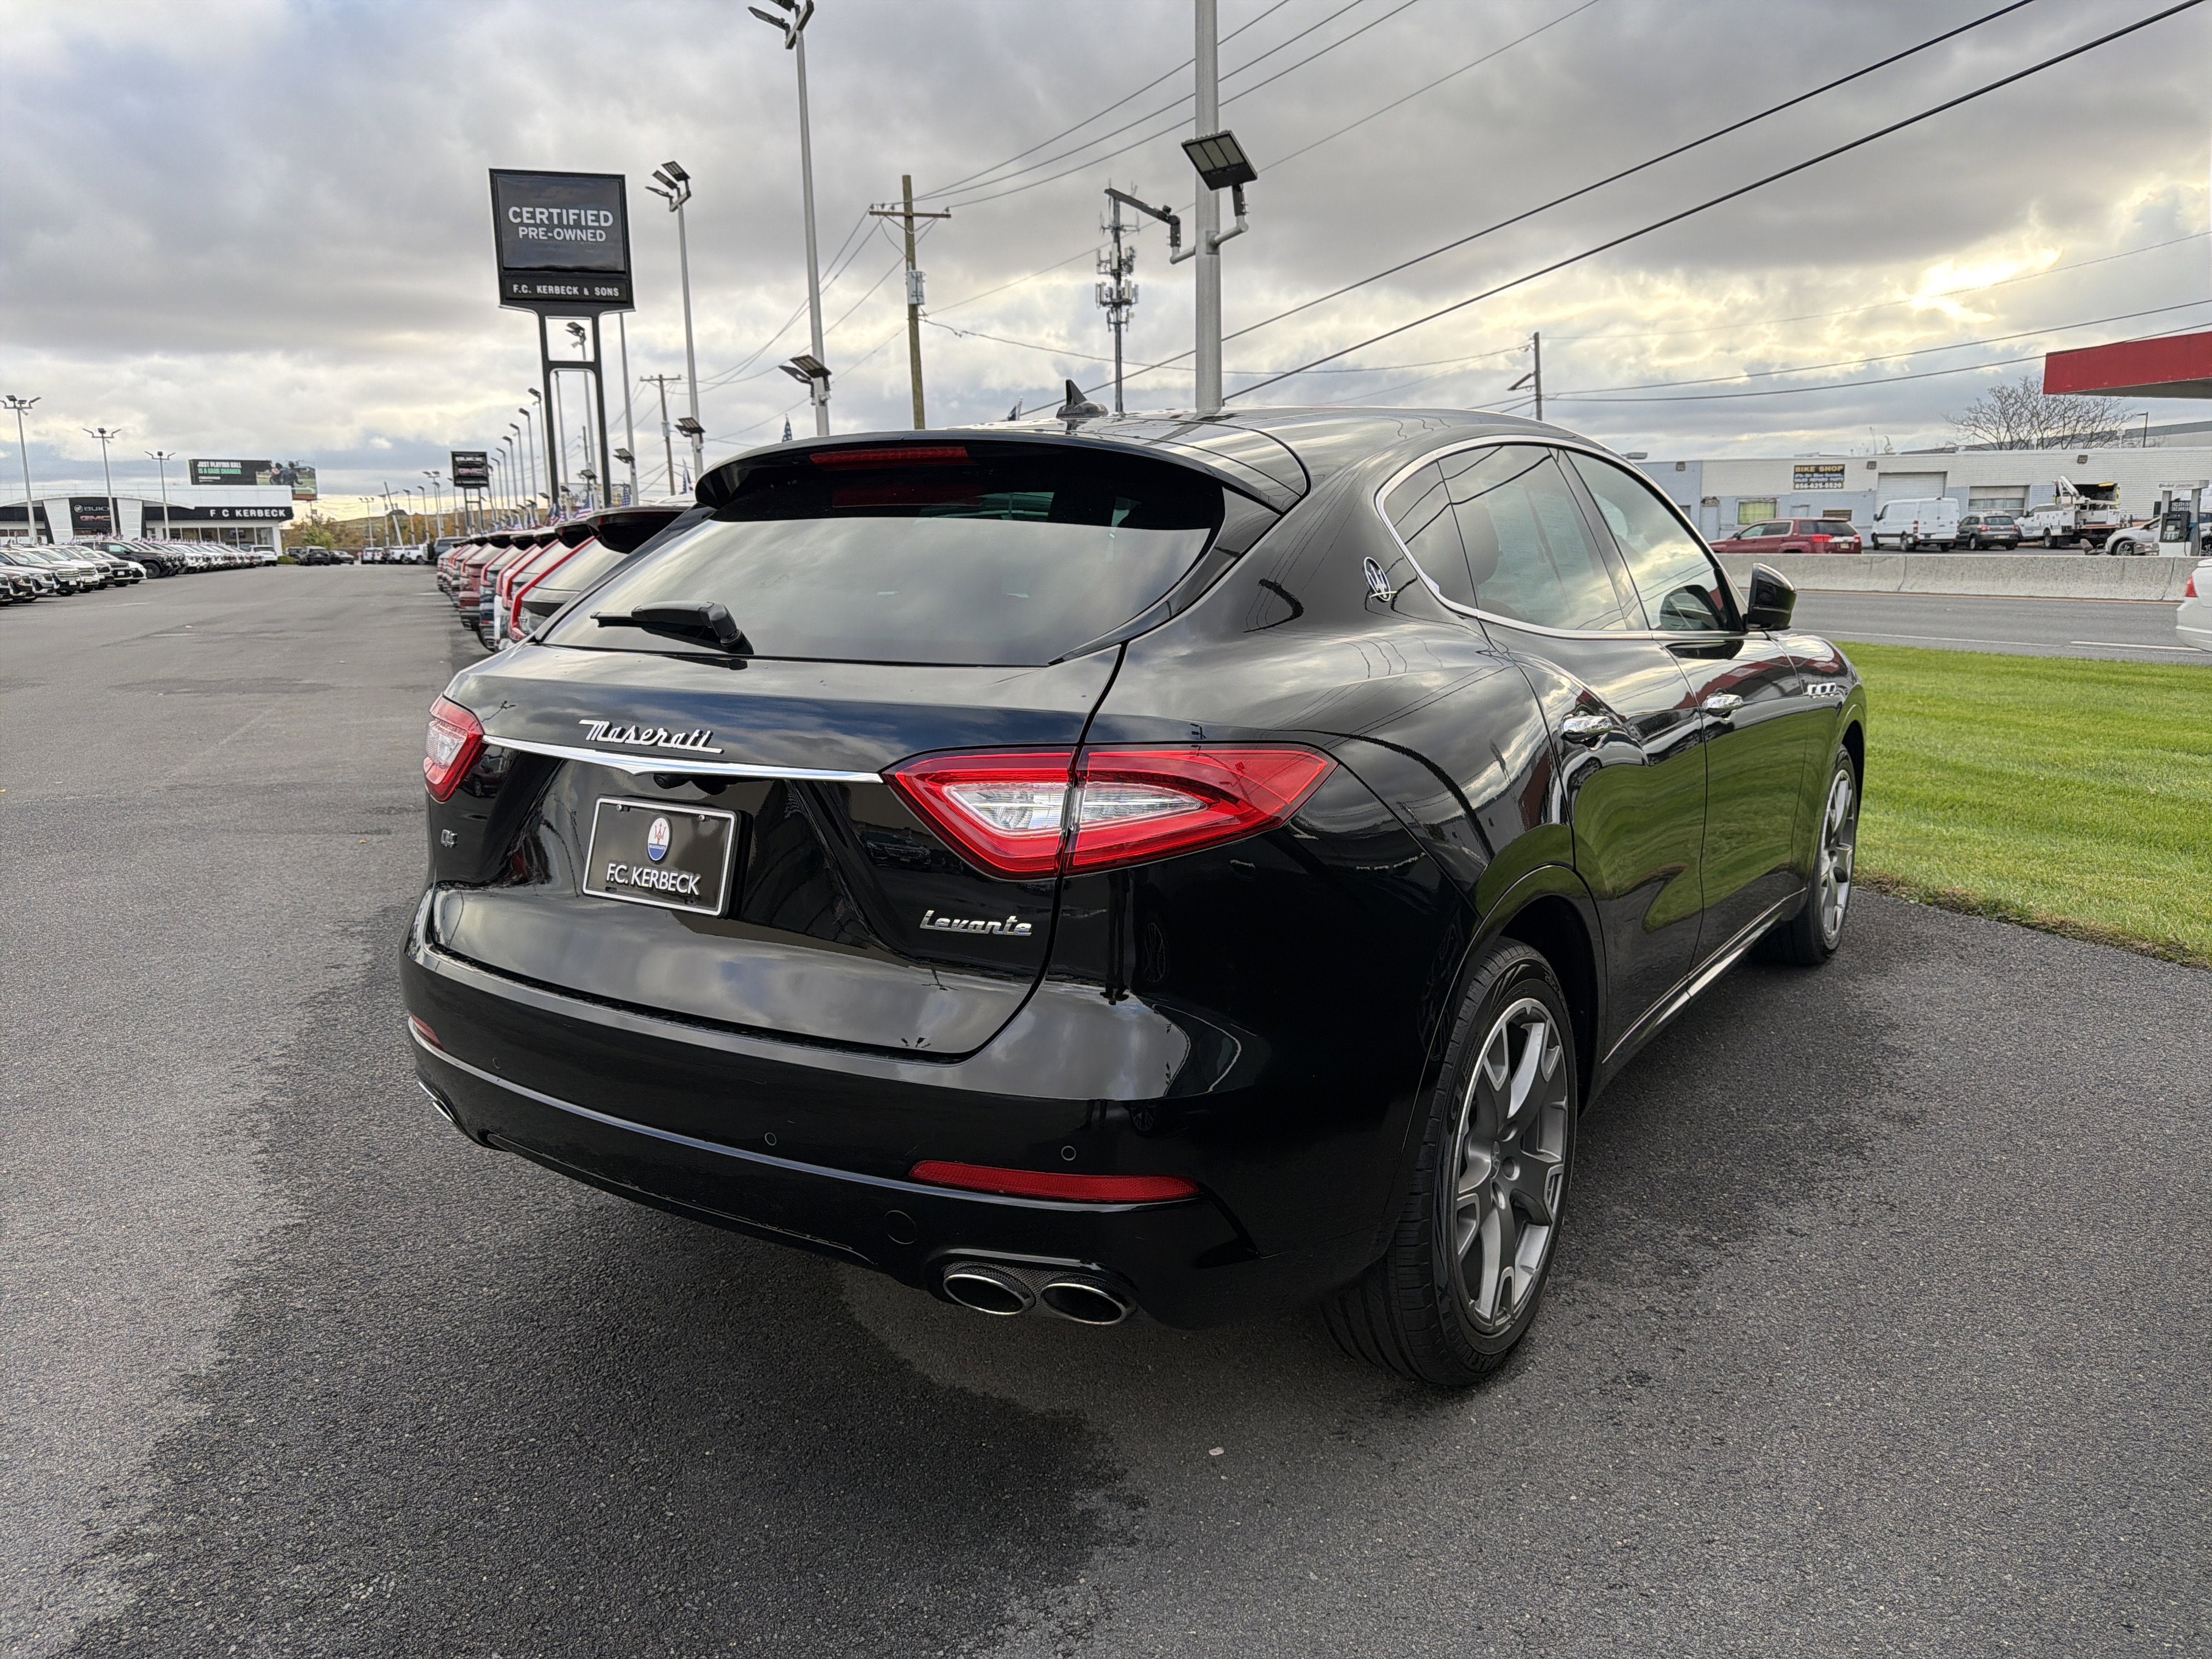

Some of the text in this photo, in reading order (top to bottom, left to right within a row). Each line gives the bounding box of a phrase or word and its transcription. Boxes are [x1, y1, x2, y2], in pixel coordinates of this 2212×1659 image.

[509, 207, 613, 227] CERTIFIED
[518, 227, 606, 241] PRE-OWNED
[513, 284, 532, 294] F.C.
[537, 285, 579, 295] KERBECK
[594, 287, 619, 297] SONS
[579, 719, 723, 753] Maserati
[606, 863, 702, 895] F.C. KERBECK
[919, 910, 1032, 936] Levante
